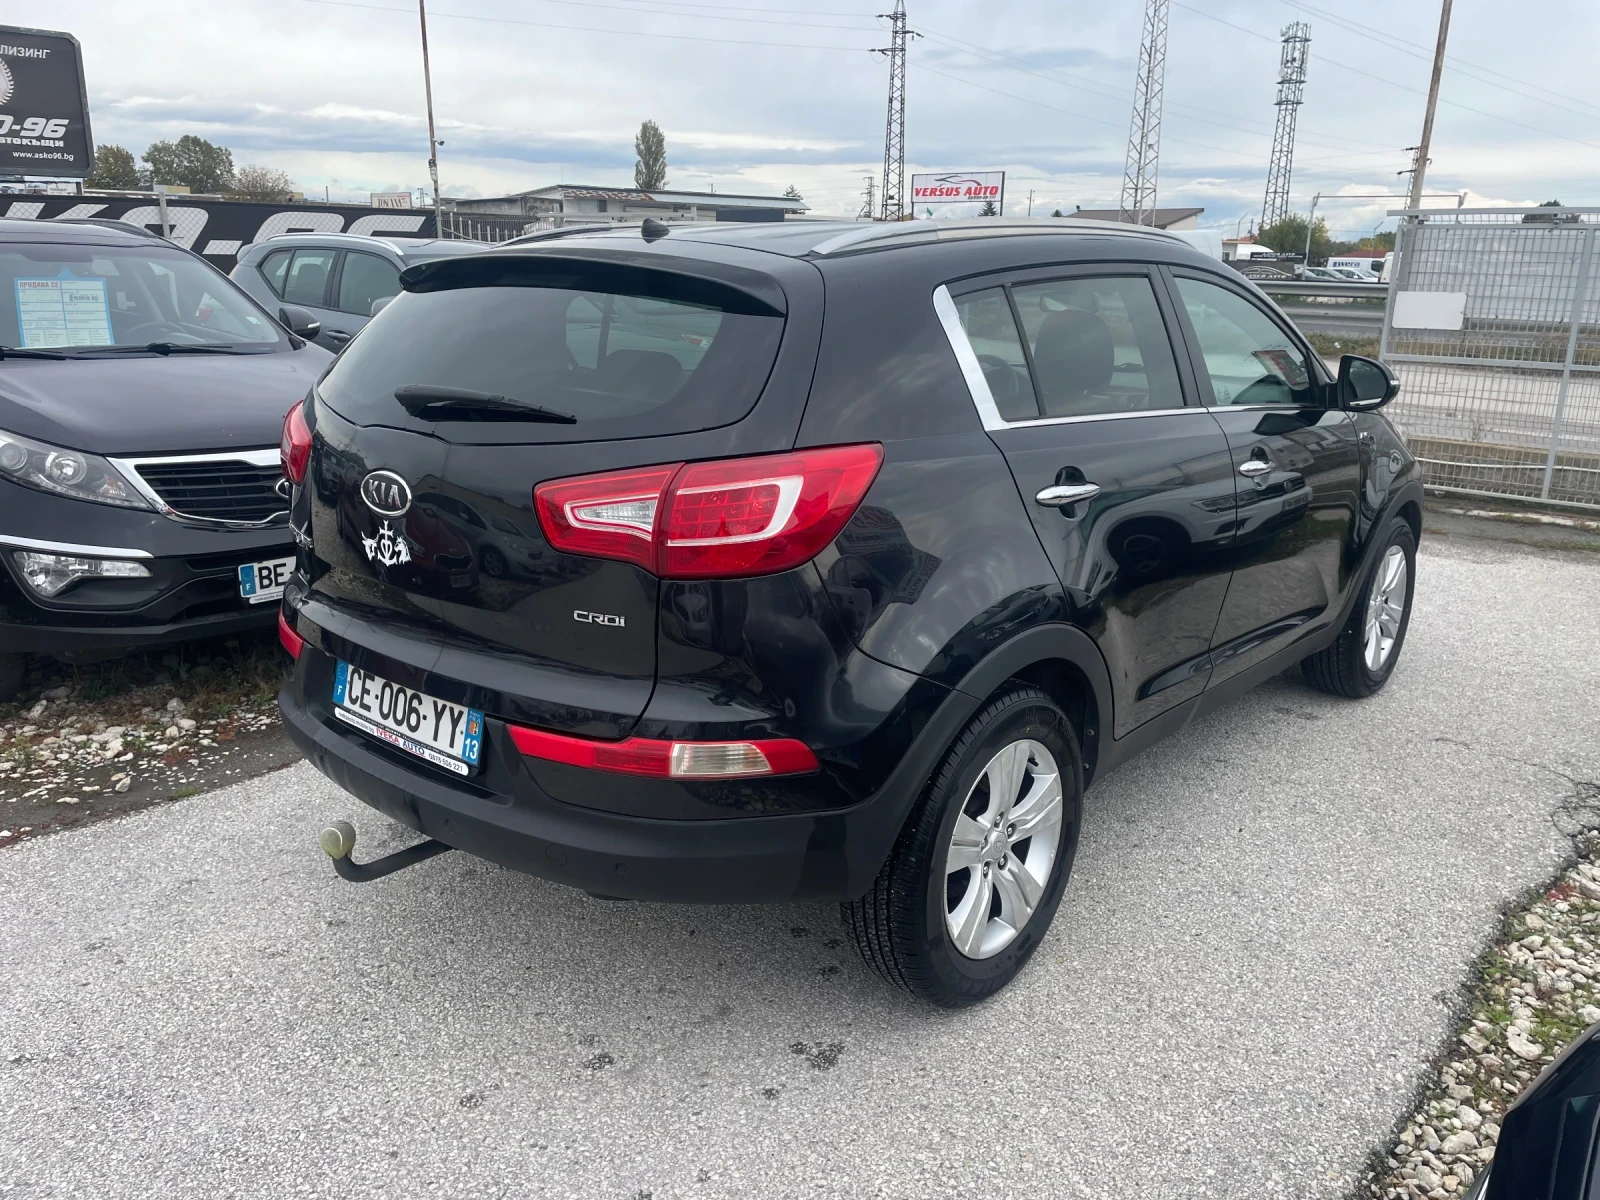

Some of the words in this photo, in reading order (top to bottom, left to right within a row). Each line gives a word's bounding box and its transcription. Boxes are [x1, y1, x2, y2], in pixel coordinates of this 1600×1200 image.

[12, 151, 74, 162] www.asko96.bg
[914, 187, 961, 197] VERSUS
[964, 186, 999, 196] AUTO
[368, 478, 402, 509] KIA
[245, 583, 251, 591] F
[336, 684, 343, 696] F
[348, 667, 464, 749] CE-006-YY
[375, 727, 399, 744] IVEKA
[402, 740, 425, 755] AUTO
[465, 737, 479, 760] 13
